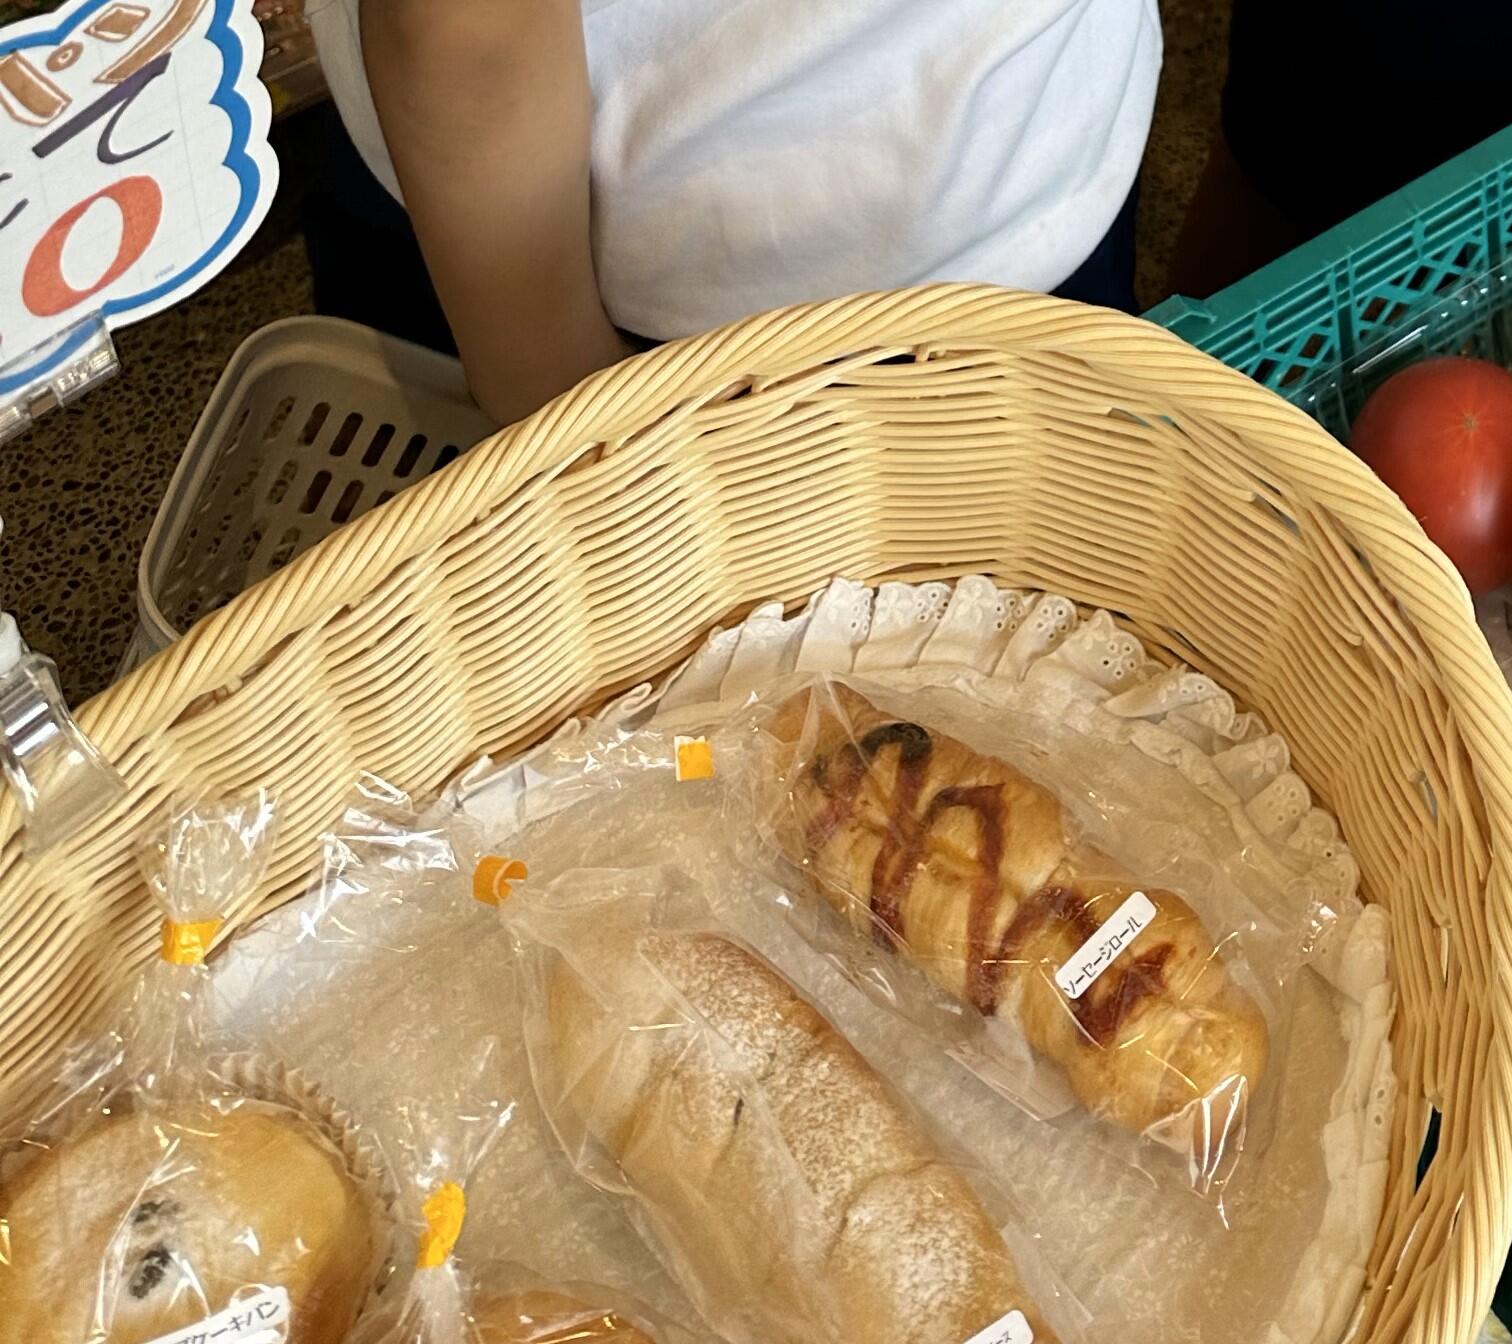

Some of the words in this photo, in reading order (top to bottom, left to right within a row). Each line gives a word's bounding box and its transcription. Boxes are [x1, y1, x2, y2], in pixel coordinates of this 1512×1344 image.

[1064, 916, 1142, 995] ソーセージロール
